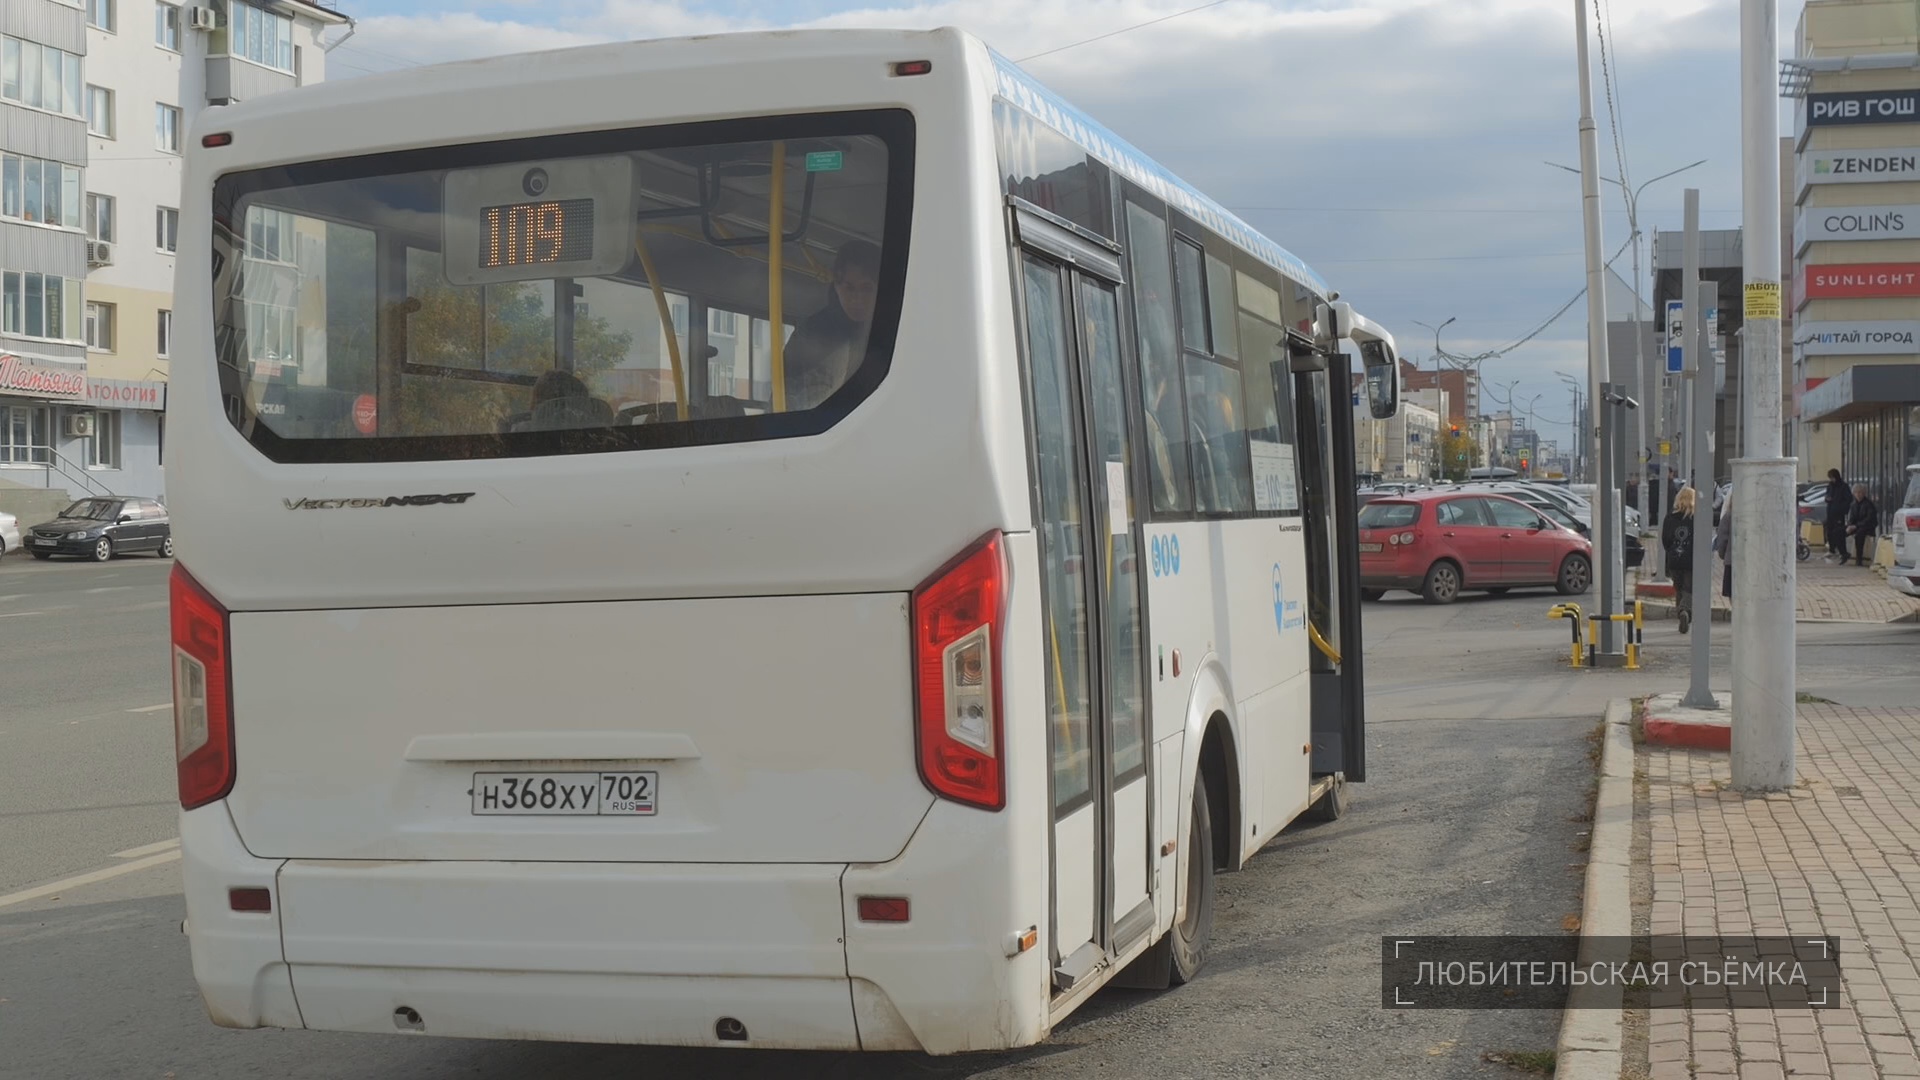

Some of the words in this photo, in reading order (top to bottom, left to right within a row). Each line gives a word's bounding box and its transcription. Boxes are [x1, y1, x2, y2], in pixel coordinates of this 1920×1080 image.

[1813, 100, 1860, 118] РИВ
[1865, 98, 1915, 116] ГОШ
[1833, 156, 1915, 174] ZENDEN
[1824, 211, 1904, 232] COLIN'S
[1816, 273, 1915, 286] SUNLIGHT
[1812, 330, 1860, 343] ЧИТАЙ
[1865, 332, 1913, 344] ГОРОД
[0, 355, 83, 394] Татьяна
[483, 778, 595, 809] Н368ХУ
[603, 776, 648, 800] 702
[612, 802, 635, 811] RUS
